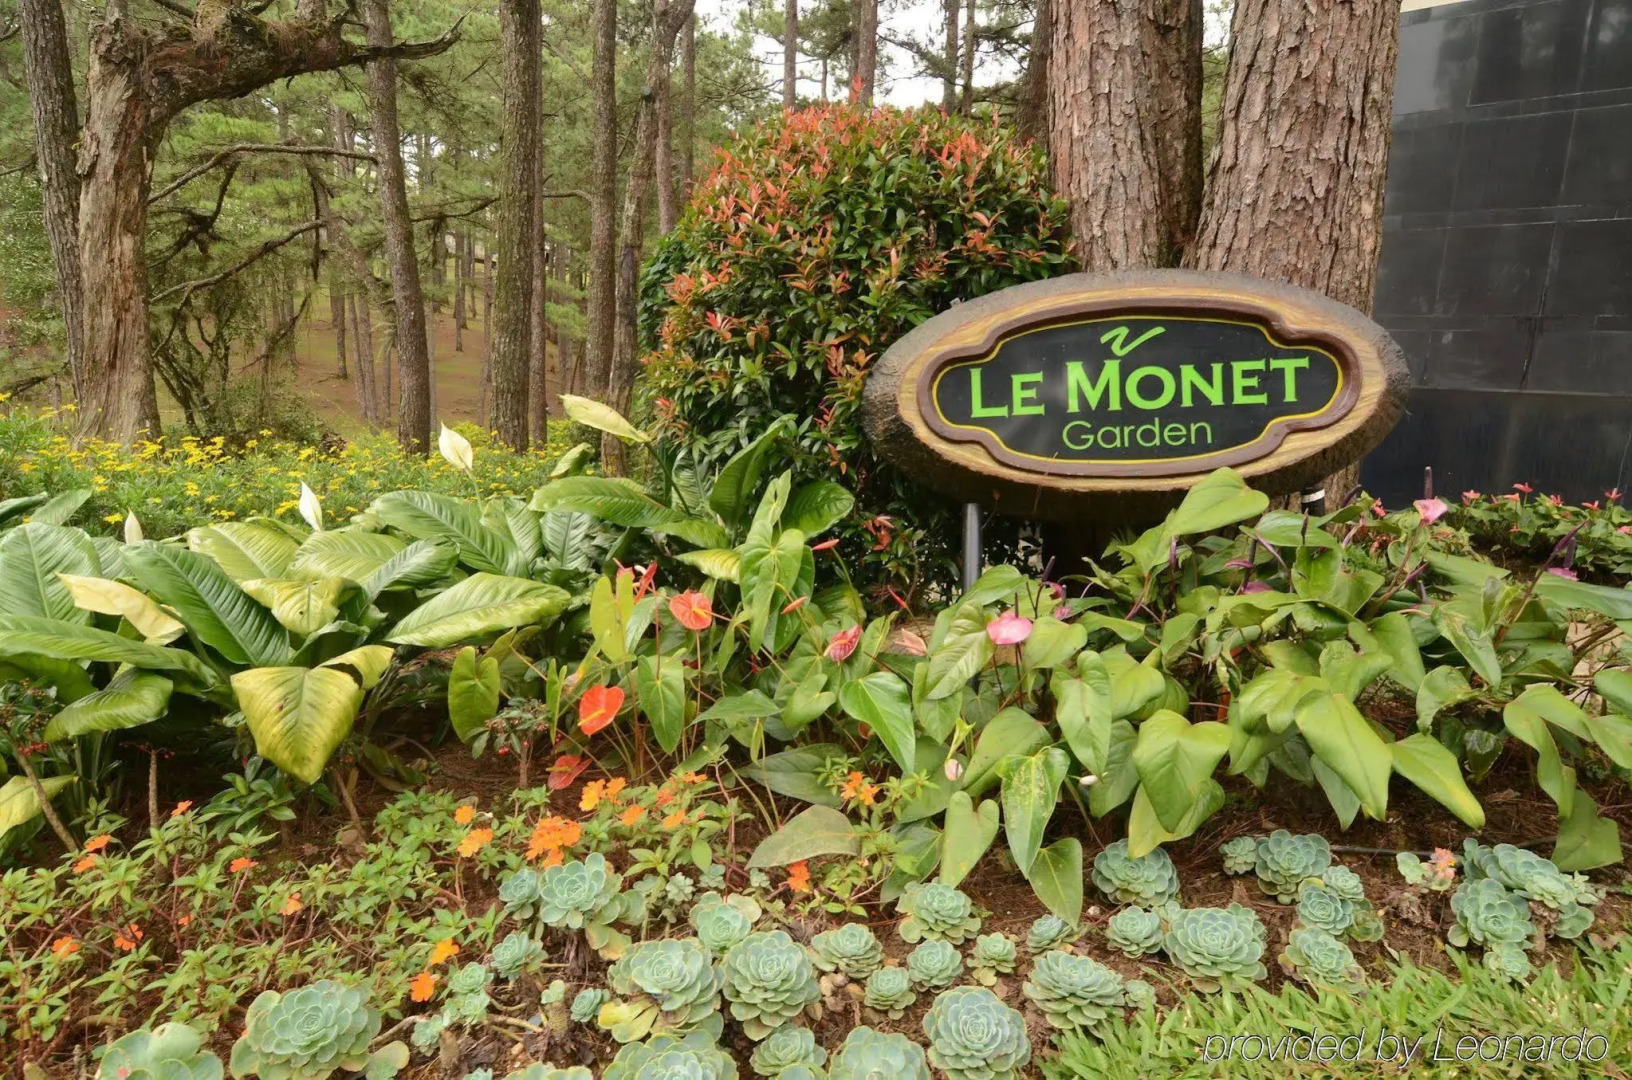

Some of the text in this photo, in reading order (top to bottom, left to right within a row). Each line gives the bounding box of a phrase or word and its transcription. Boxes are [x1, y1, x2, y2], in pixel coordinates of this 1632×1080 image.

[969, 357, 1310, 418] LE MONET
[1062, 417, 1212, 450] Garden
